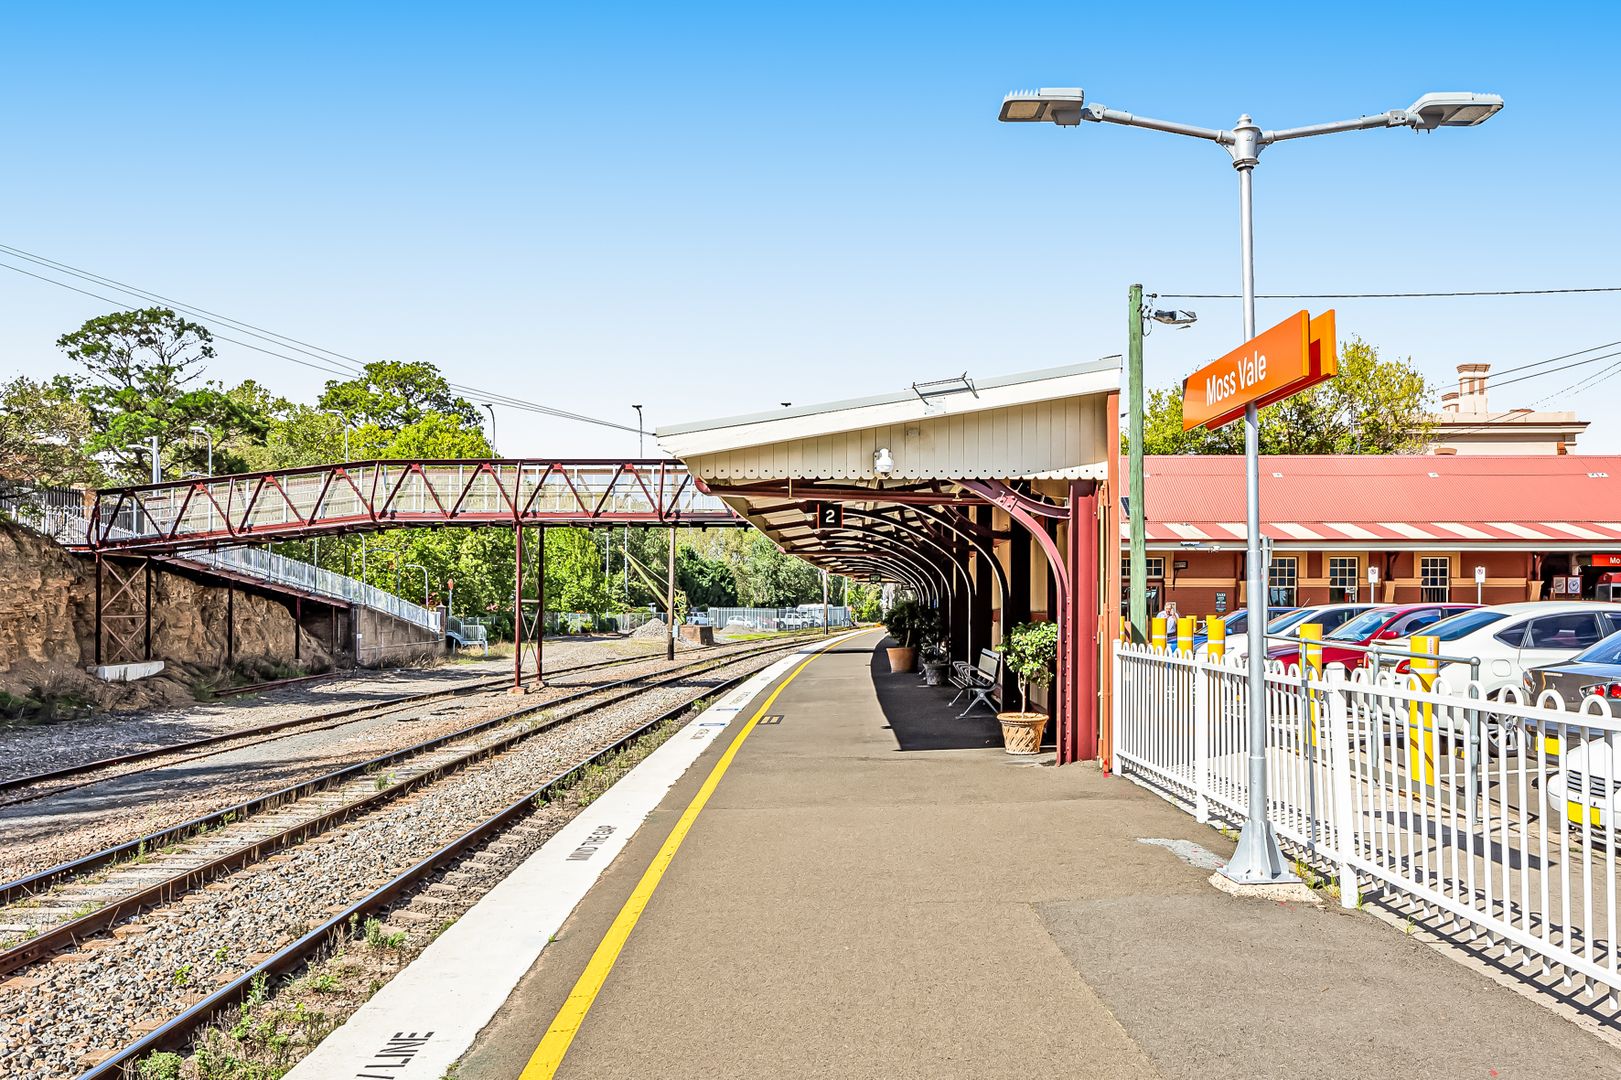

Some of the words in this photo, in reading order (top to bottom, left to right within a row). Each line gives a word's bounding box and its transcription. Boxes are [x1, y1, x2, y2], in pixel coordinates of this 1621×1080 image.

[1206, 370, 1236, 407] Moss
[1237, 350, 1267, 390] Vale
[825, 509, 835, 523] 2
[364, 1031, 435, 1069] LINE
